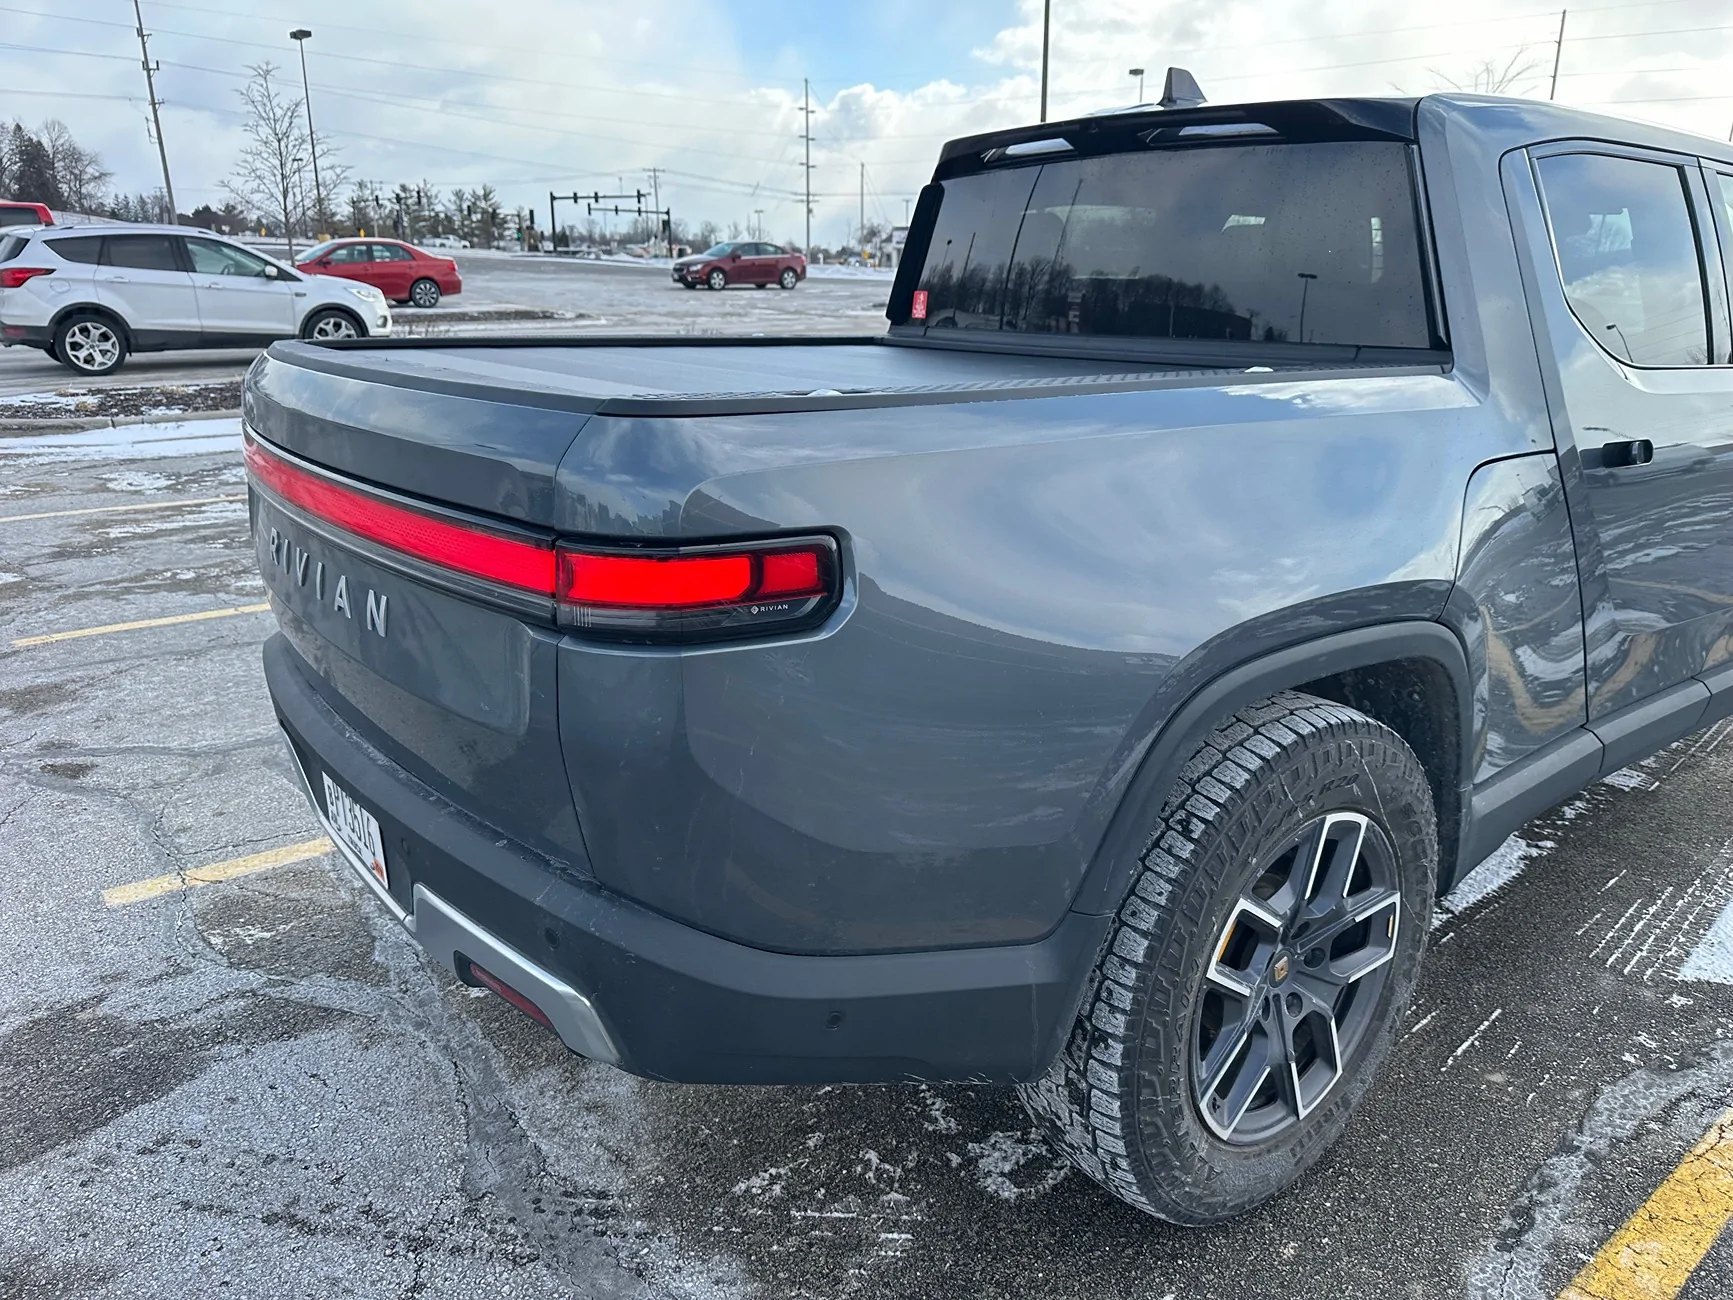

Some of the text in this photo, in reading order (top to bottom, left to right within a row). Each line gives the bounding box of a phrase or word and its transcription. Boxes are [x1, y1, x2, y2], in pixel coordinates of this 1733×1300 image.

[270, 527, 388, 637] RIVIAN
[760, 604, 789, 612] RIVIAN
[1170, 957, 1202, 1150] TERRAIN
